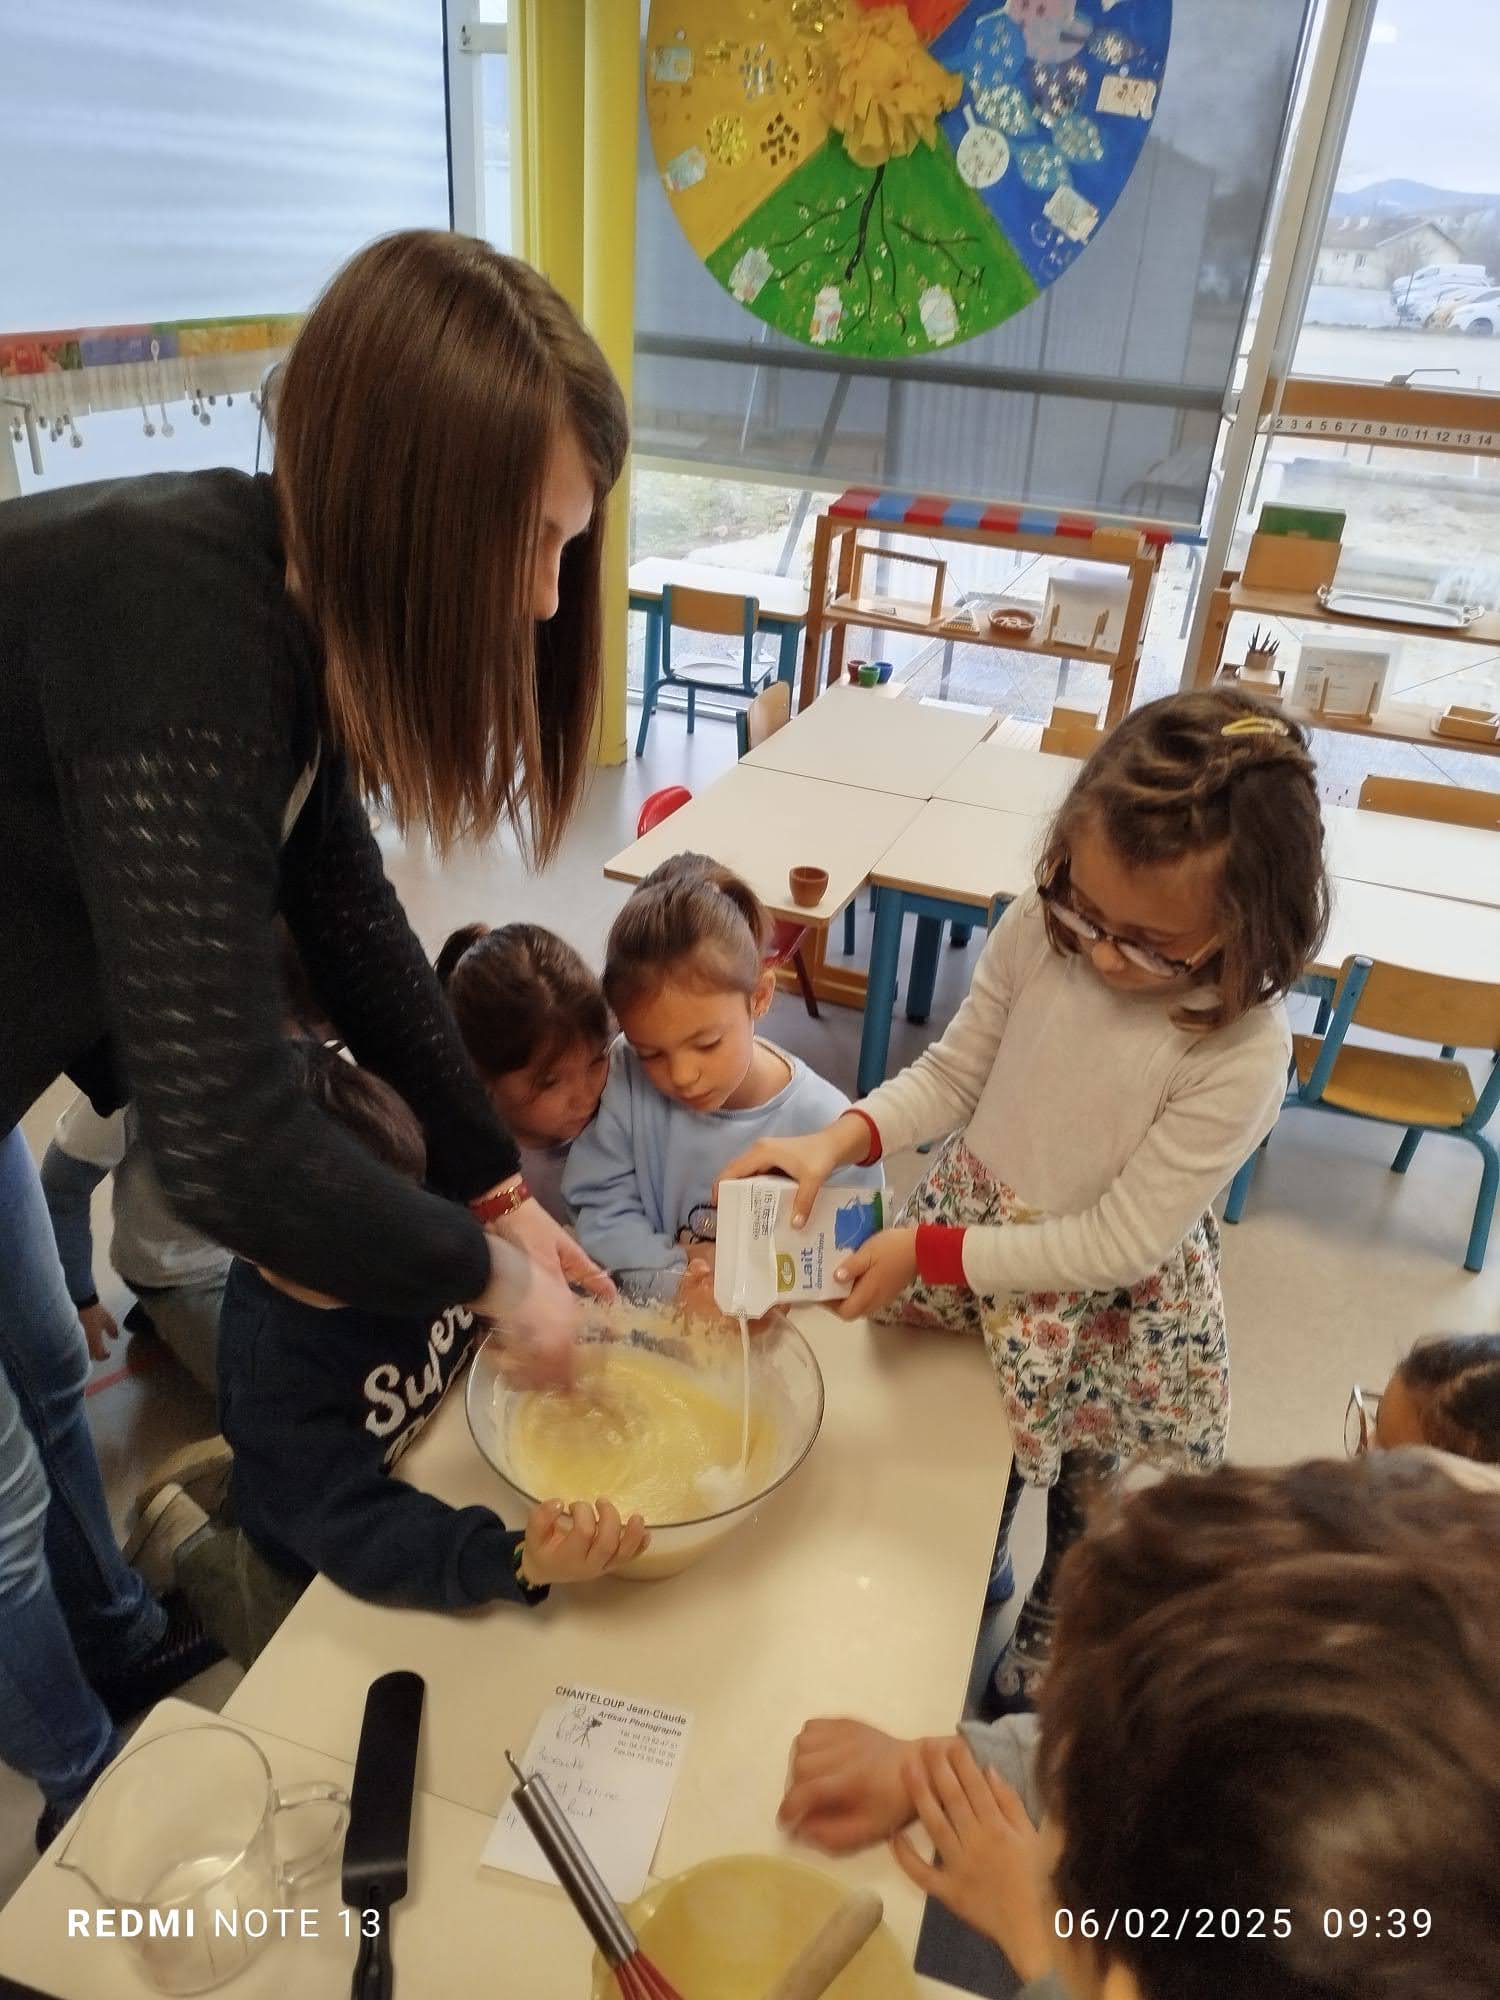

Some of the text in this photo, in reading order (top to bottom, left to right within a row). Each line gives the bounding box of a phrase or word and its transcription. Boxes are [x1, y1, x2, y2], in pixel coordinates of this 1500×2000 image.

[1275, 418, 1493, 445] 2 3 4 5 6 7 8 9 10 11 12 13 14
[801, 1247, 813, 1289] Lait
[555, 1685, 687, 1725] CHANTELOUP Jean-Claude
[598, 1711, 682, 1737] Artisan Photographe
